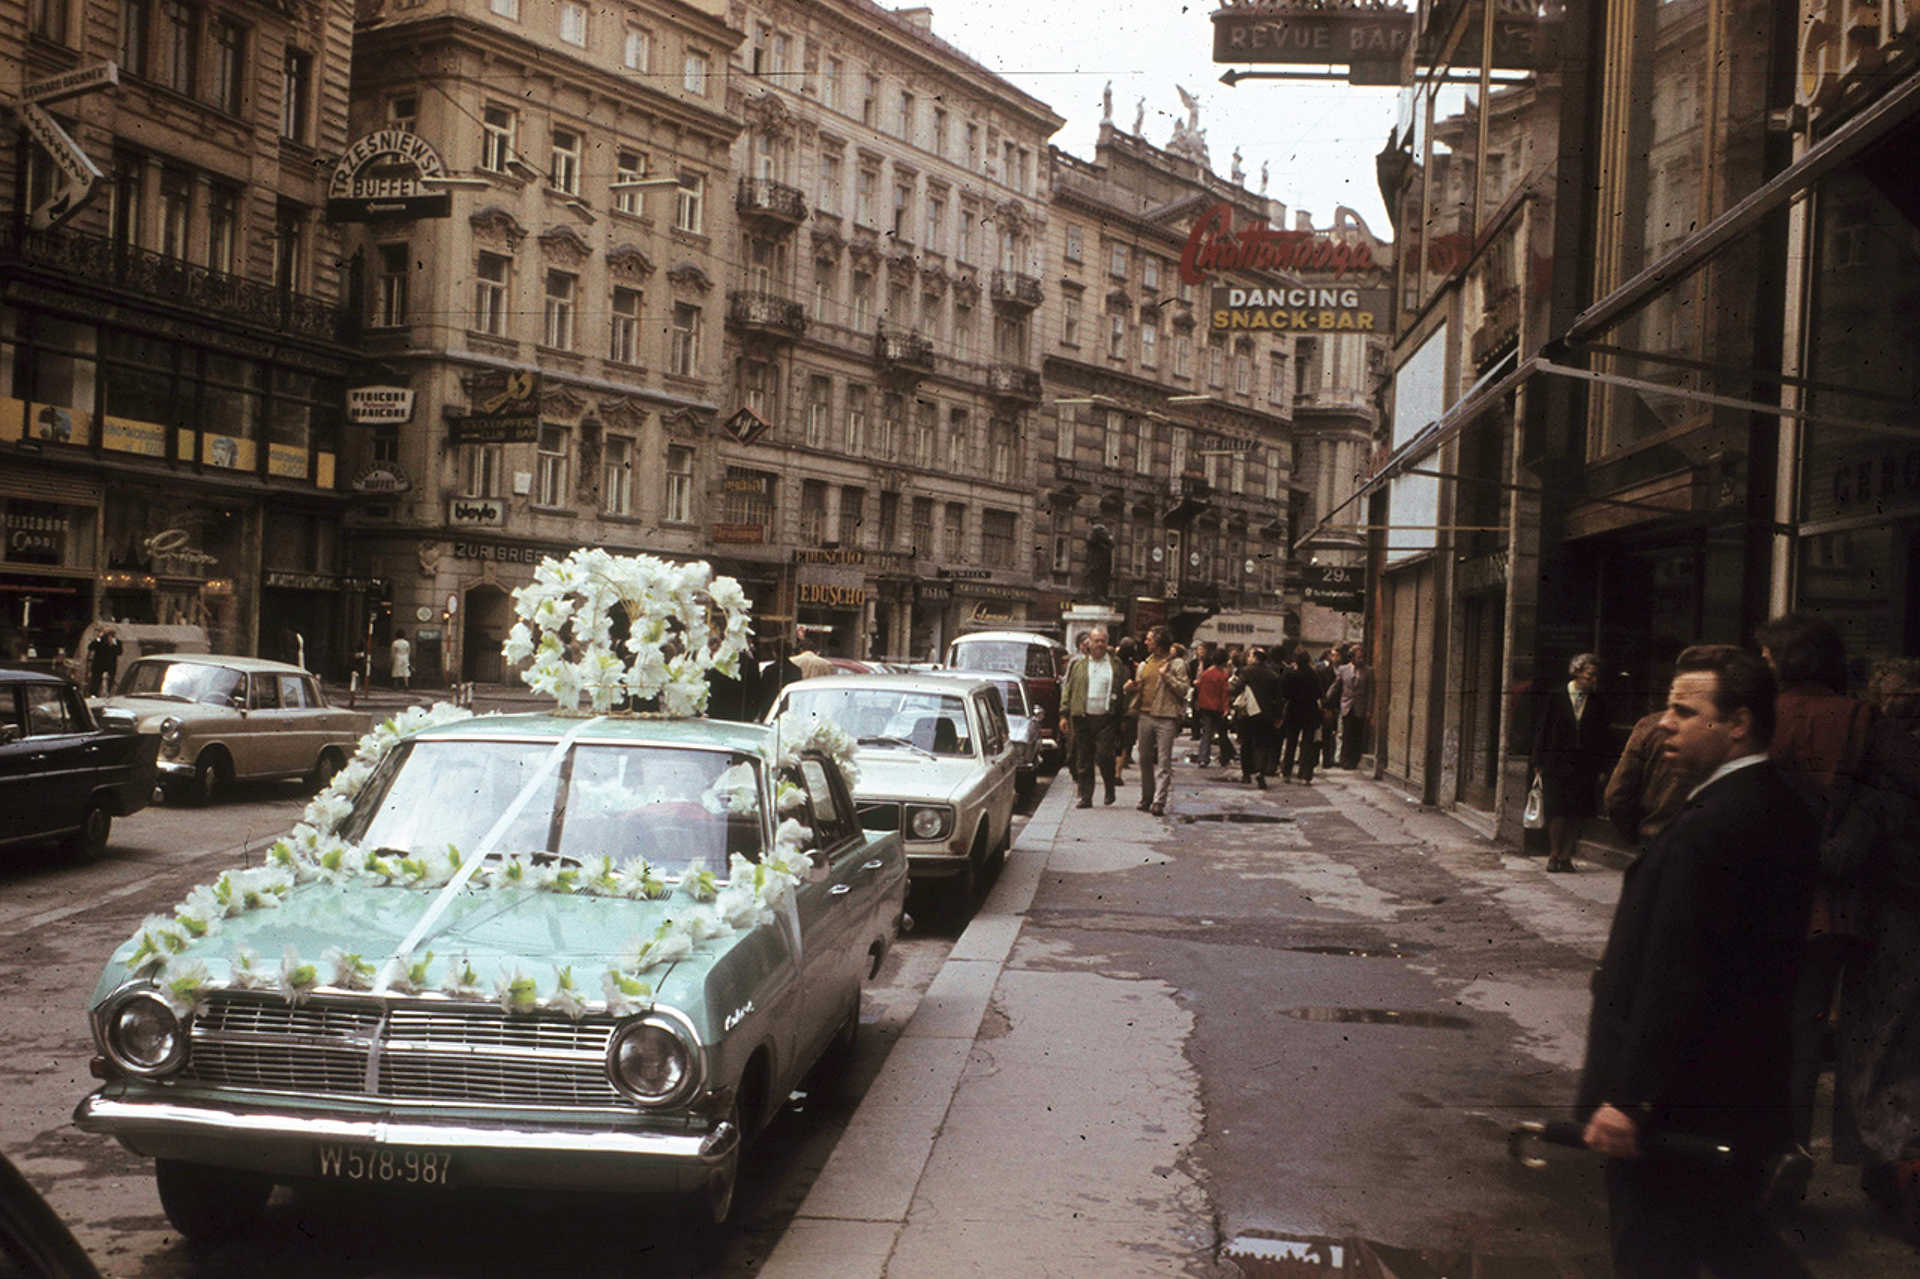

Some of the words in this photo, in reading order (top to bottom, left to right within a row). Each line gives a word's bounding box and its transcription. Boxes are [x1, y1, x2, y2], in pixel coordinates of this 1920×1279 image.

[1231, 26, 1329, 49] REVUE
[1352, 28, 1406, 50] BAR
[354, 179, 419, 196] BUFFET
[1229, 289, 1359, 308] DANCING
[1213, 310, 1374, 329] SNACK-BAR
[455, 542, 489, 559] ZUR
[796, 550, 863, 564] EDUSCHO
[800, 583, 865, 606] EDUSCHO
[320, 1144, 343, 1176] W
